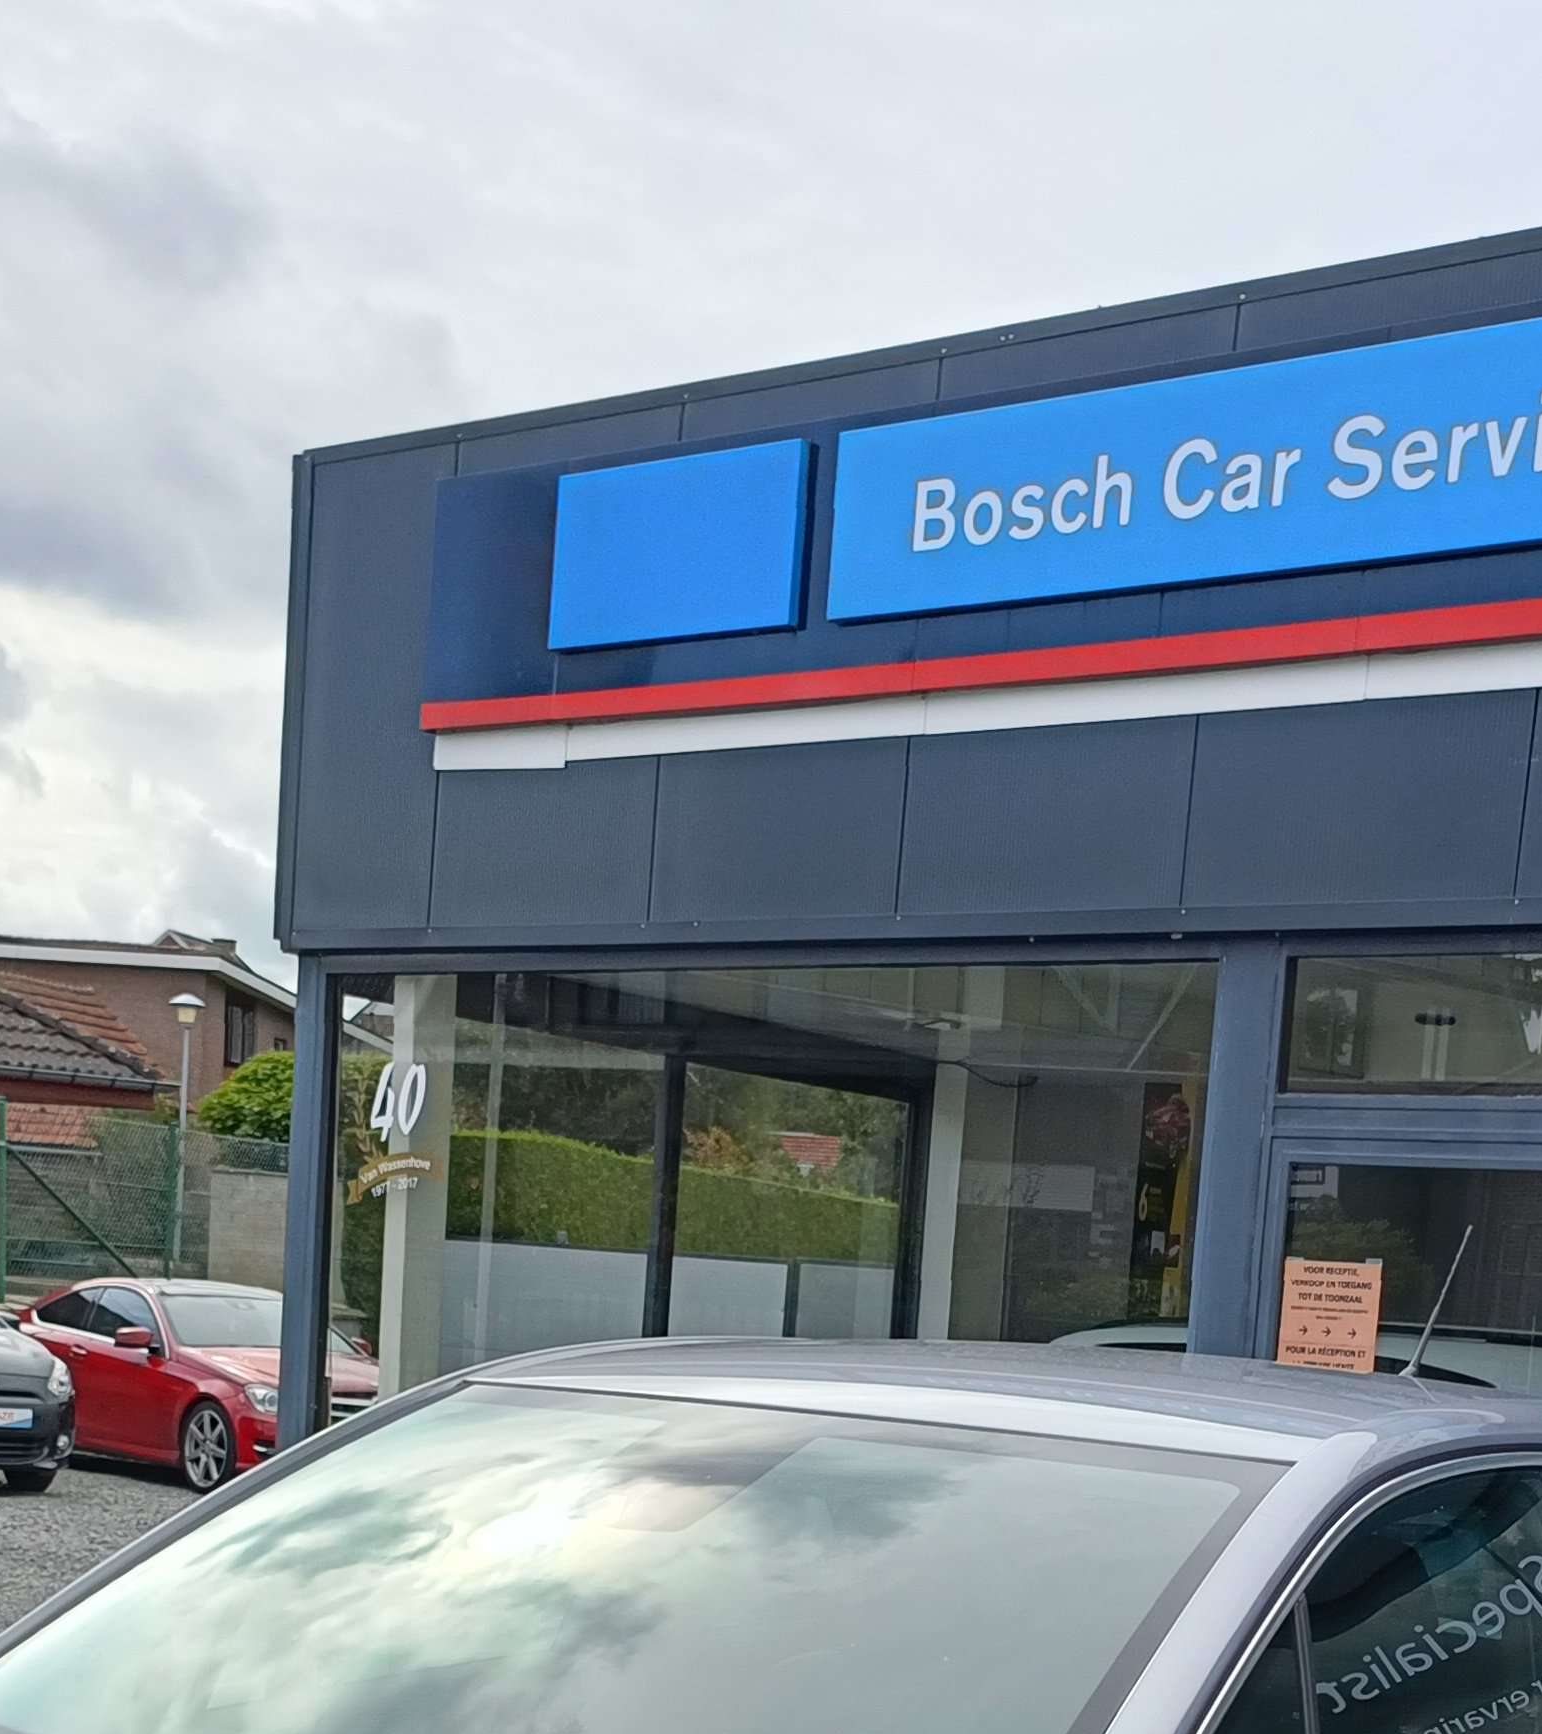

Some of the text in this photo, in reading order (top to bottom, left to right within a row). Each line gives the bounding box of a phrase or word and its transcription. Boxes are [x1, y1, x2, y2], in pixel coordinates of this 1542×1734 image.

[912, 454, 1133, 553] Bosch
[1162, 437, 1302, 521] Car
[370, 1062, 427, 1142] 40
[359, 1168, 378, 1184] Van
[1303, 1266, 1324, 1274] VOOR
[1291, 1280, 1372, 1290] VERKOOP EN TOEGANG
[1298, 1292, 1363, 1303] TOT DE TOONZAAL
[1286, 1346, 1307, 1354] POUR
[1307, 1347, 1317, 1355] LA
[1358, 1350, 1367, 1358] ET
